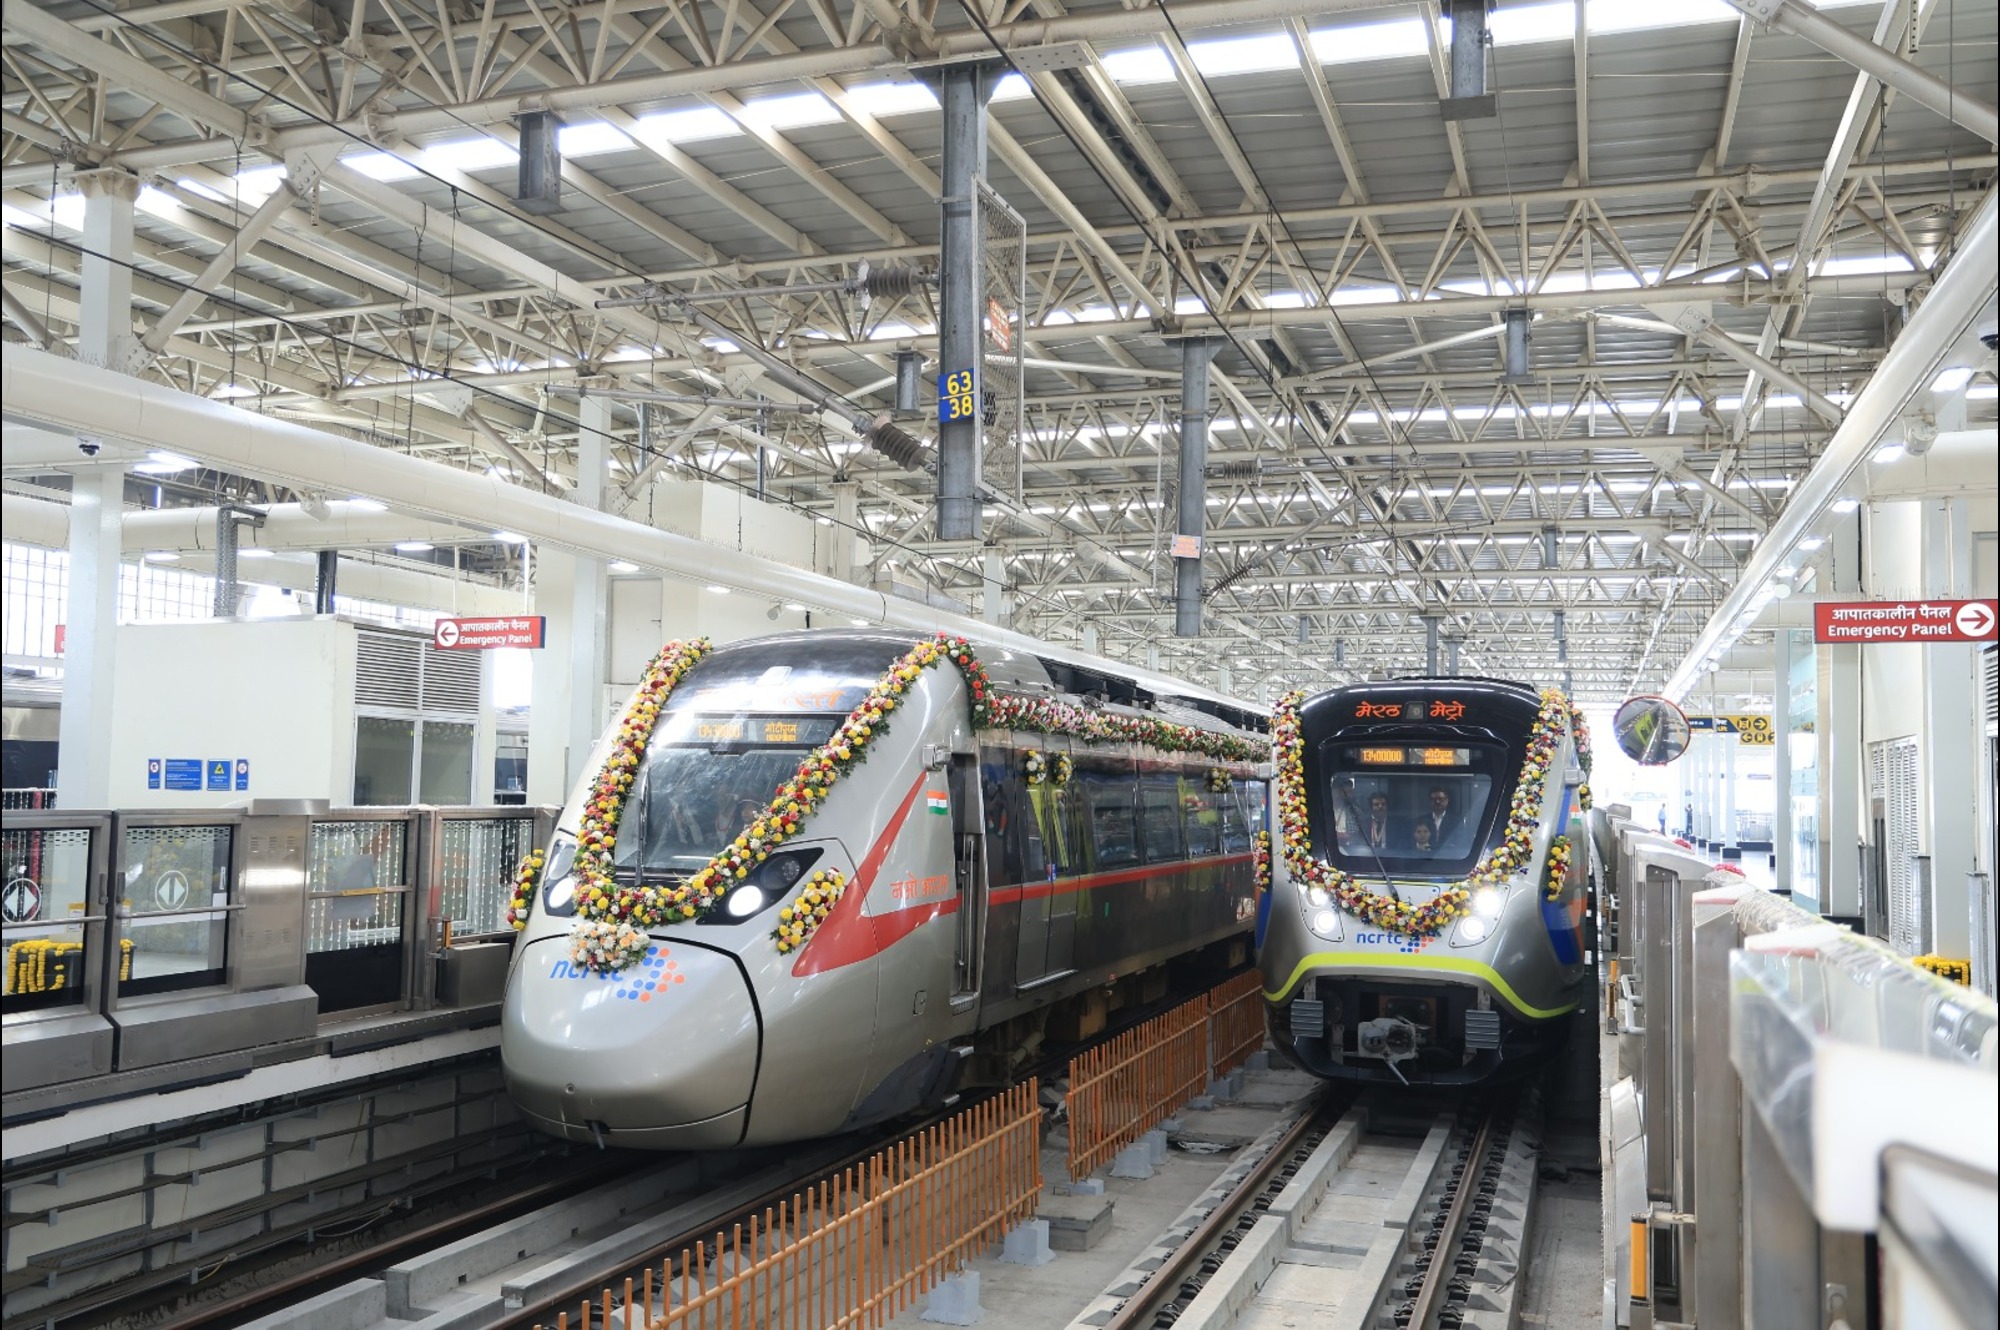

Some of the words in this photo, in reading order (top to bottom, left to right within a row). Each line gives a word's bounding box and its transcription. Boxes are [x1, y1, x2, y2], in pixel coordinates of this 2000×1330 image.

[947, 371, 972, 395] 63
[949, 395, 973, 419] 38
[1832, 605, 1917, 620] आपातकालीन
[1919, 604, 1953, 619] पैनल
[460, 619, 510, 632] आपातकालीन
[511, 618, 530, 631] पैनल
[1828, 624, 1908, 638] Emergency
[1912, 623, 1953, 635] Panel
[460, 635, 507, 645] Emergency
[509, 633, 532, 643] Panel
[1355, 701, 1402, 718] मेरठ
[1430, 700, 1466, 721] मेट्रो
[1356, 931, 1403, 945] ncrtc
